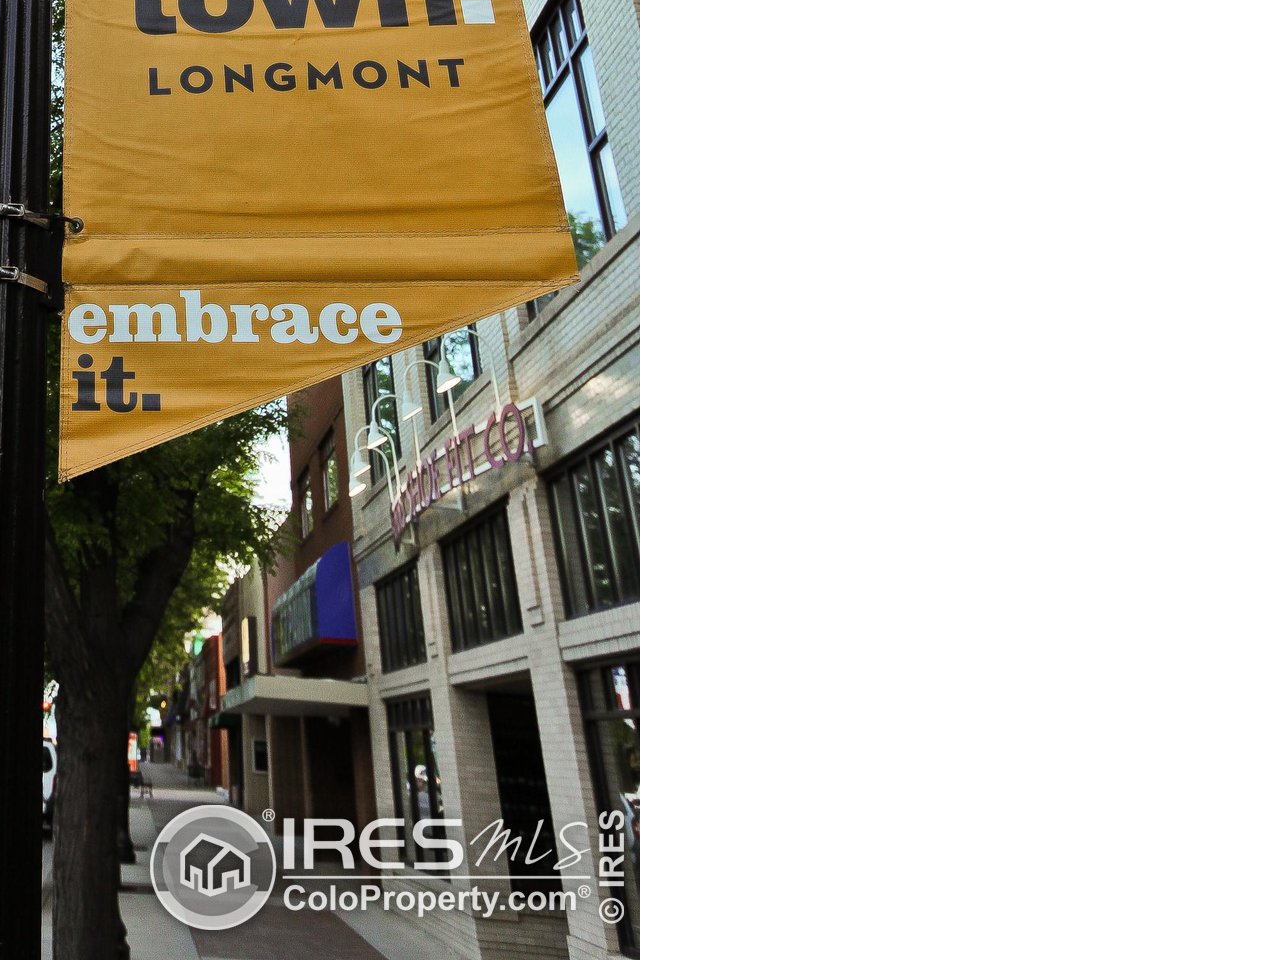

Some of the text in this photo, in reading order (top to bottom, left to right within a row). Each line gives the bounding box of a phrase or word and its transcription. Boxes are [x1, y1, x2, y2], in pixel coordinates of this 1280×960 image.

[148, 58, 465, 96] LONGMONT
[67, 289, 403, 344] embrace
[71, 353, 162, 413] it.
